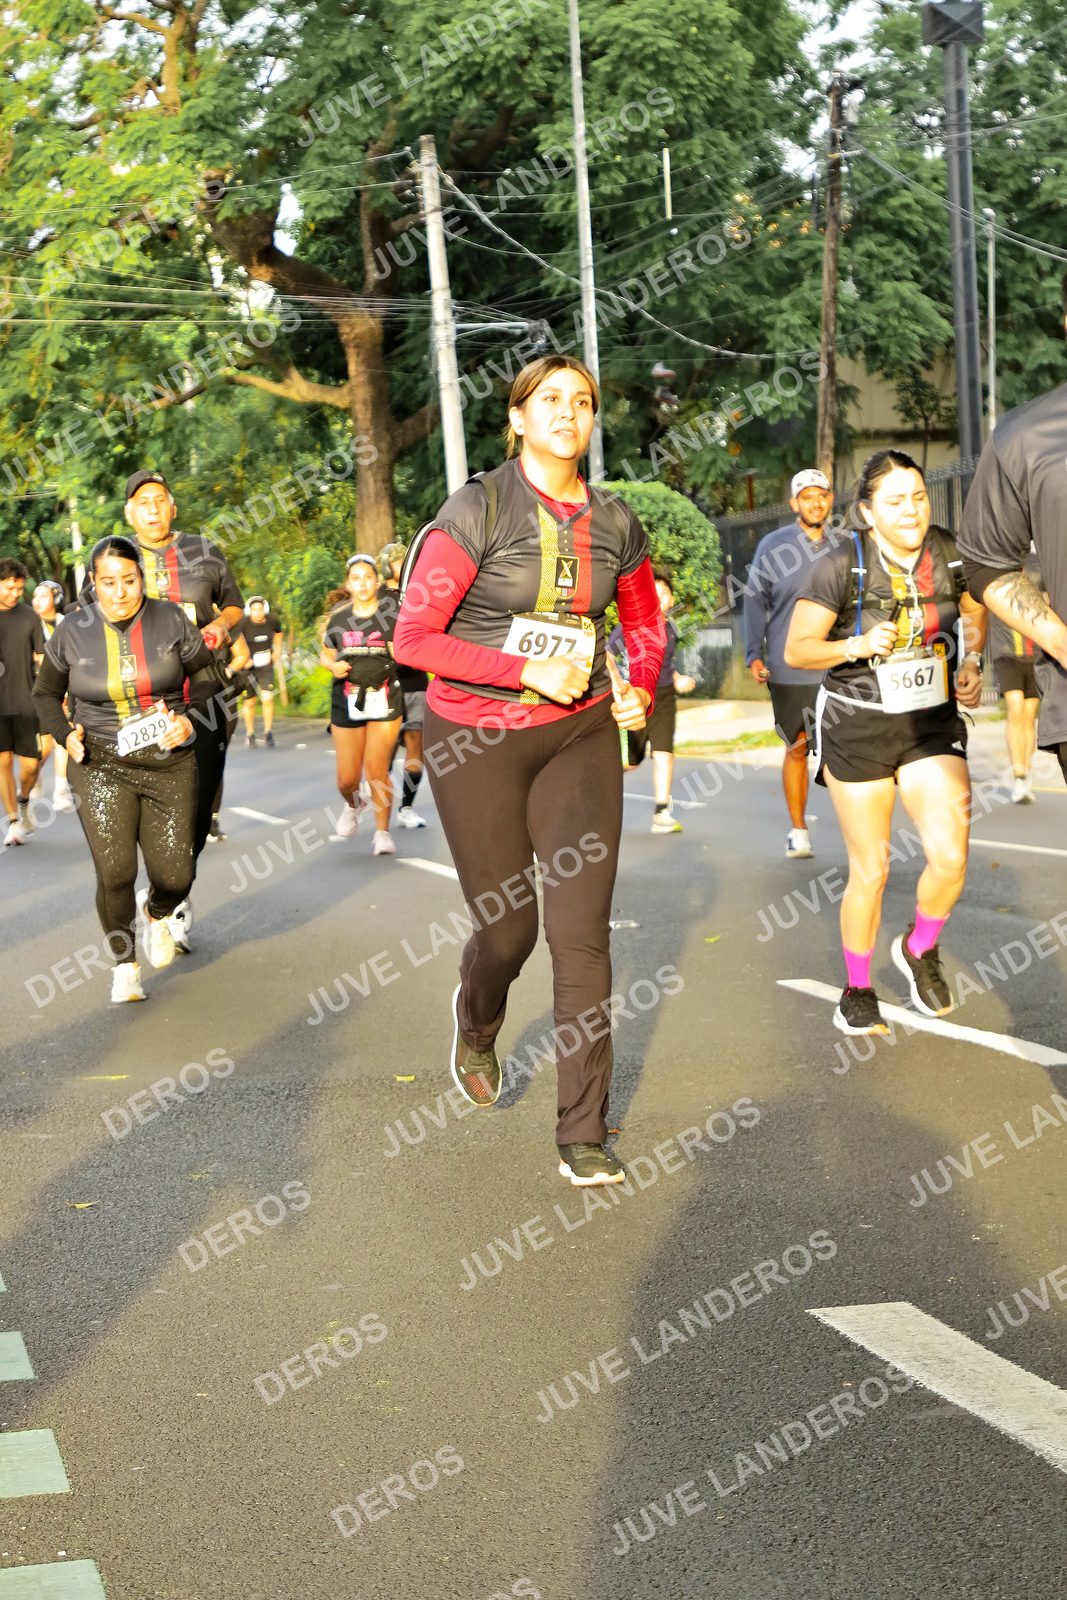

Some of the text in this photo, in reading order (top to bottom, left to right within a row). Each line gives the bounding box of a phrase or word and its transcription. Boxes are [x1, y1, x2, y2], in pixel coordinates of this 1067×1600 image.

[518, 631, 577, 658] 6977
[891, 665, 934, 690] 5667
[122, 718, 167, 749] 12829
